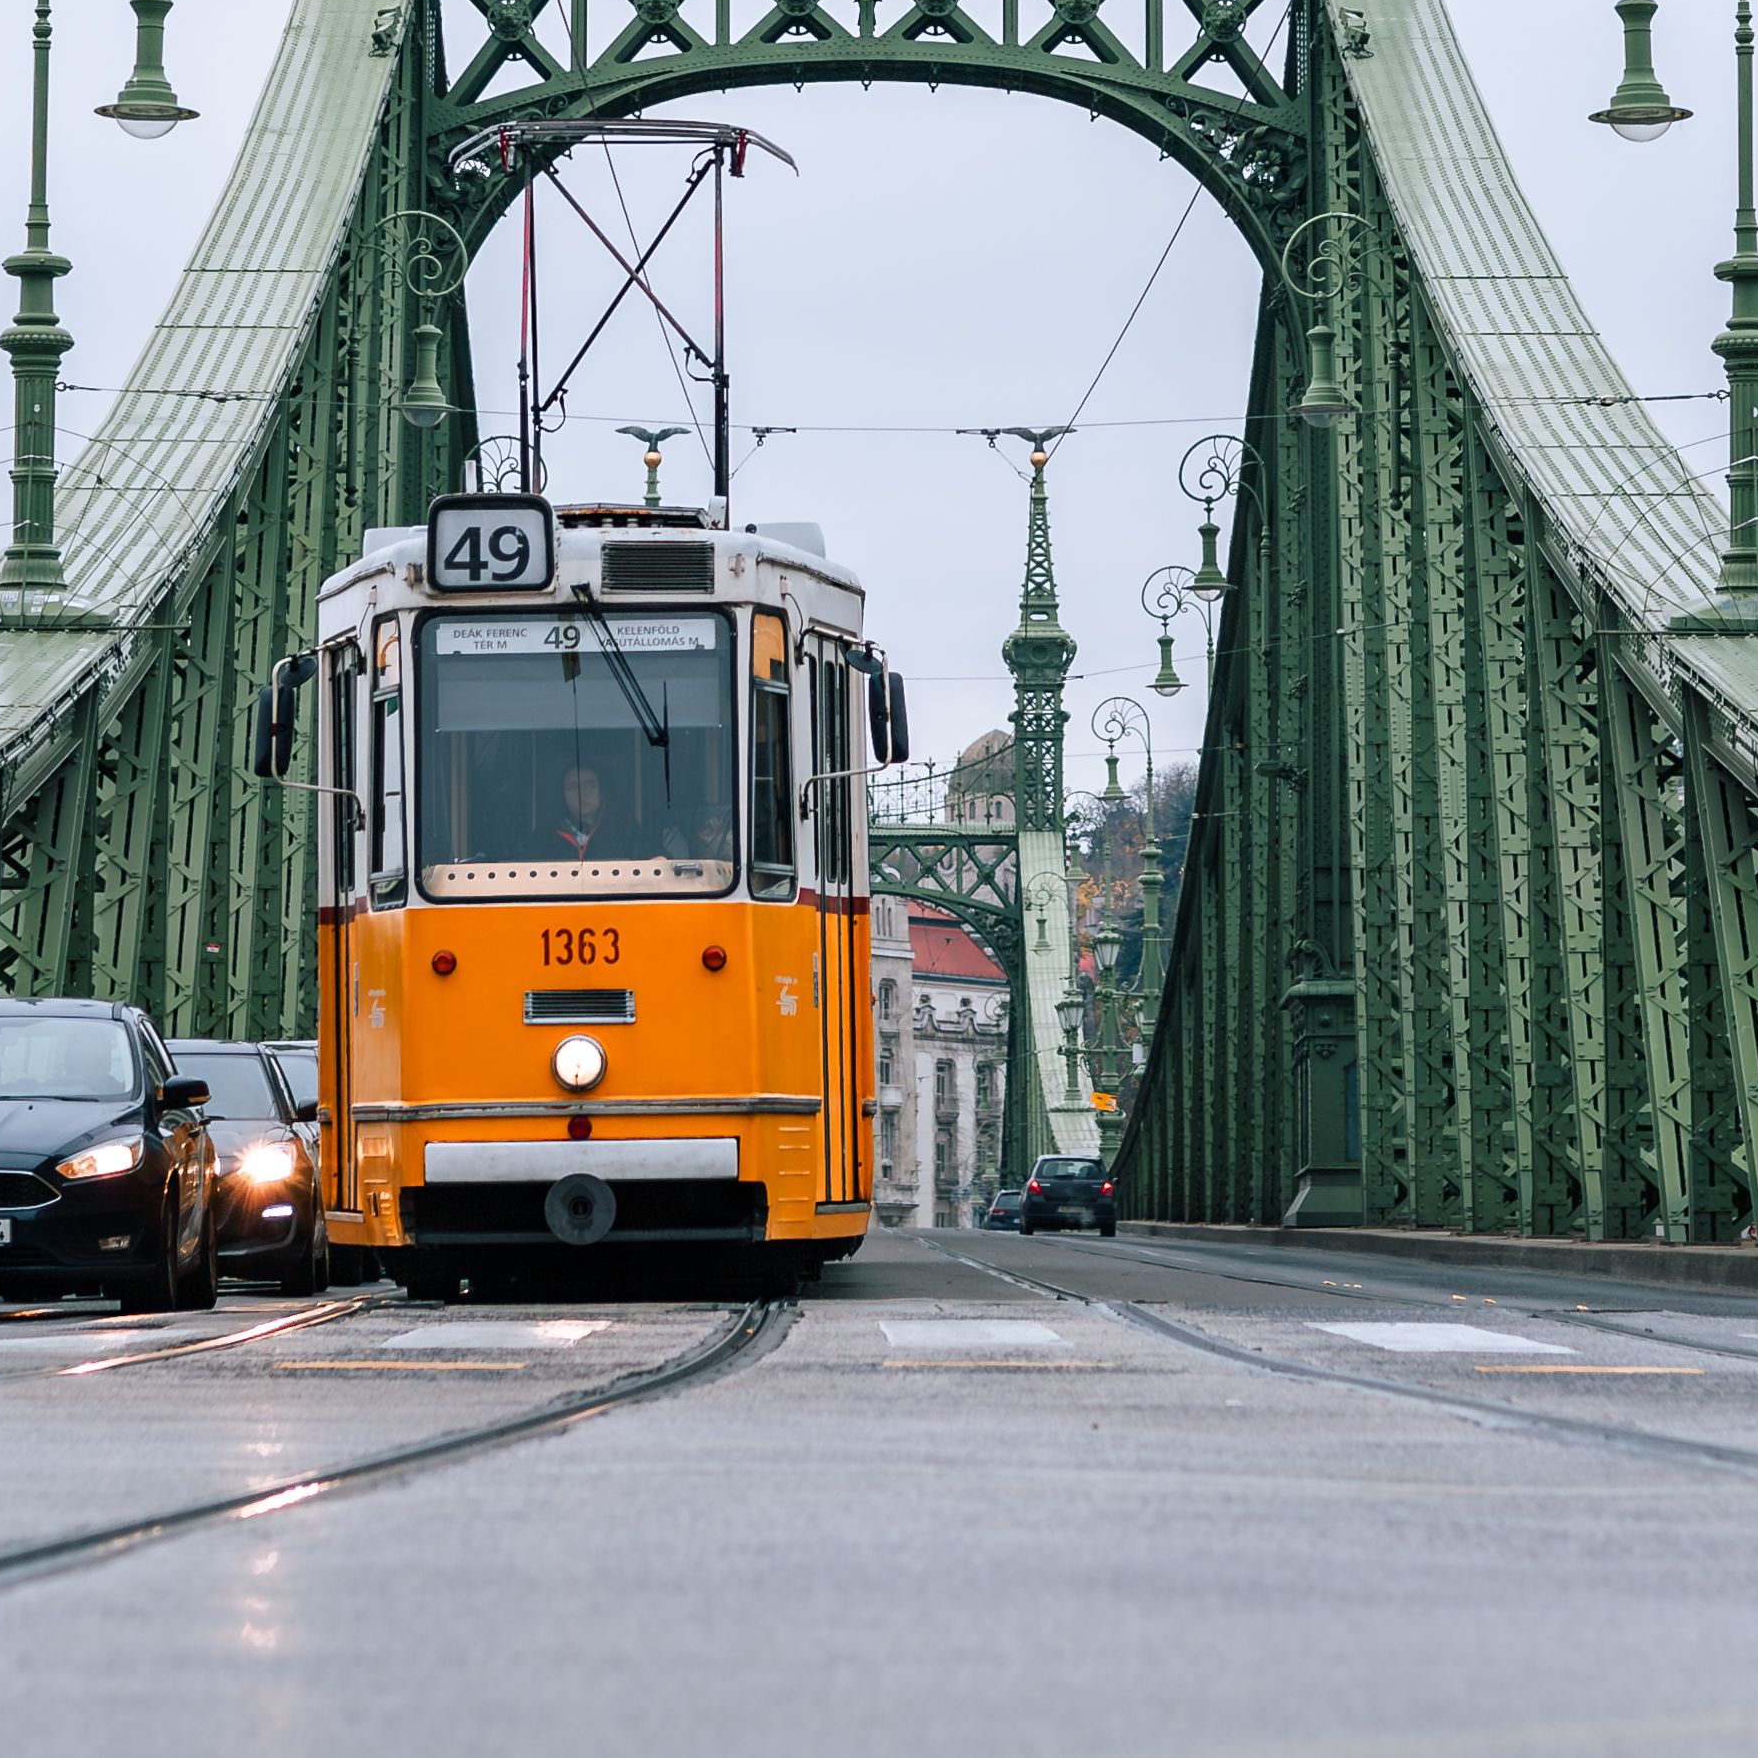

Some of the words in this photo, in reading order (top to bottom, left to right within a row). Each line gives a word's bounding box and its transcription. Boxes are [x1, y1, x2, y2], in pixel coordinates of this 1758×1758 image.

[444, 526, 530, 582] 49
[453, 627, 482, 639] DEÁK
[487, 628, 527, 638] FERENC
[544, 625, 581, 649] 49
[617, 624, 680, 636] KELENFÖLD
[474, 639, 493, 650] TÉR
[497, 640, 507, 649] M
[541, 928, 620, 966] 1363
